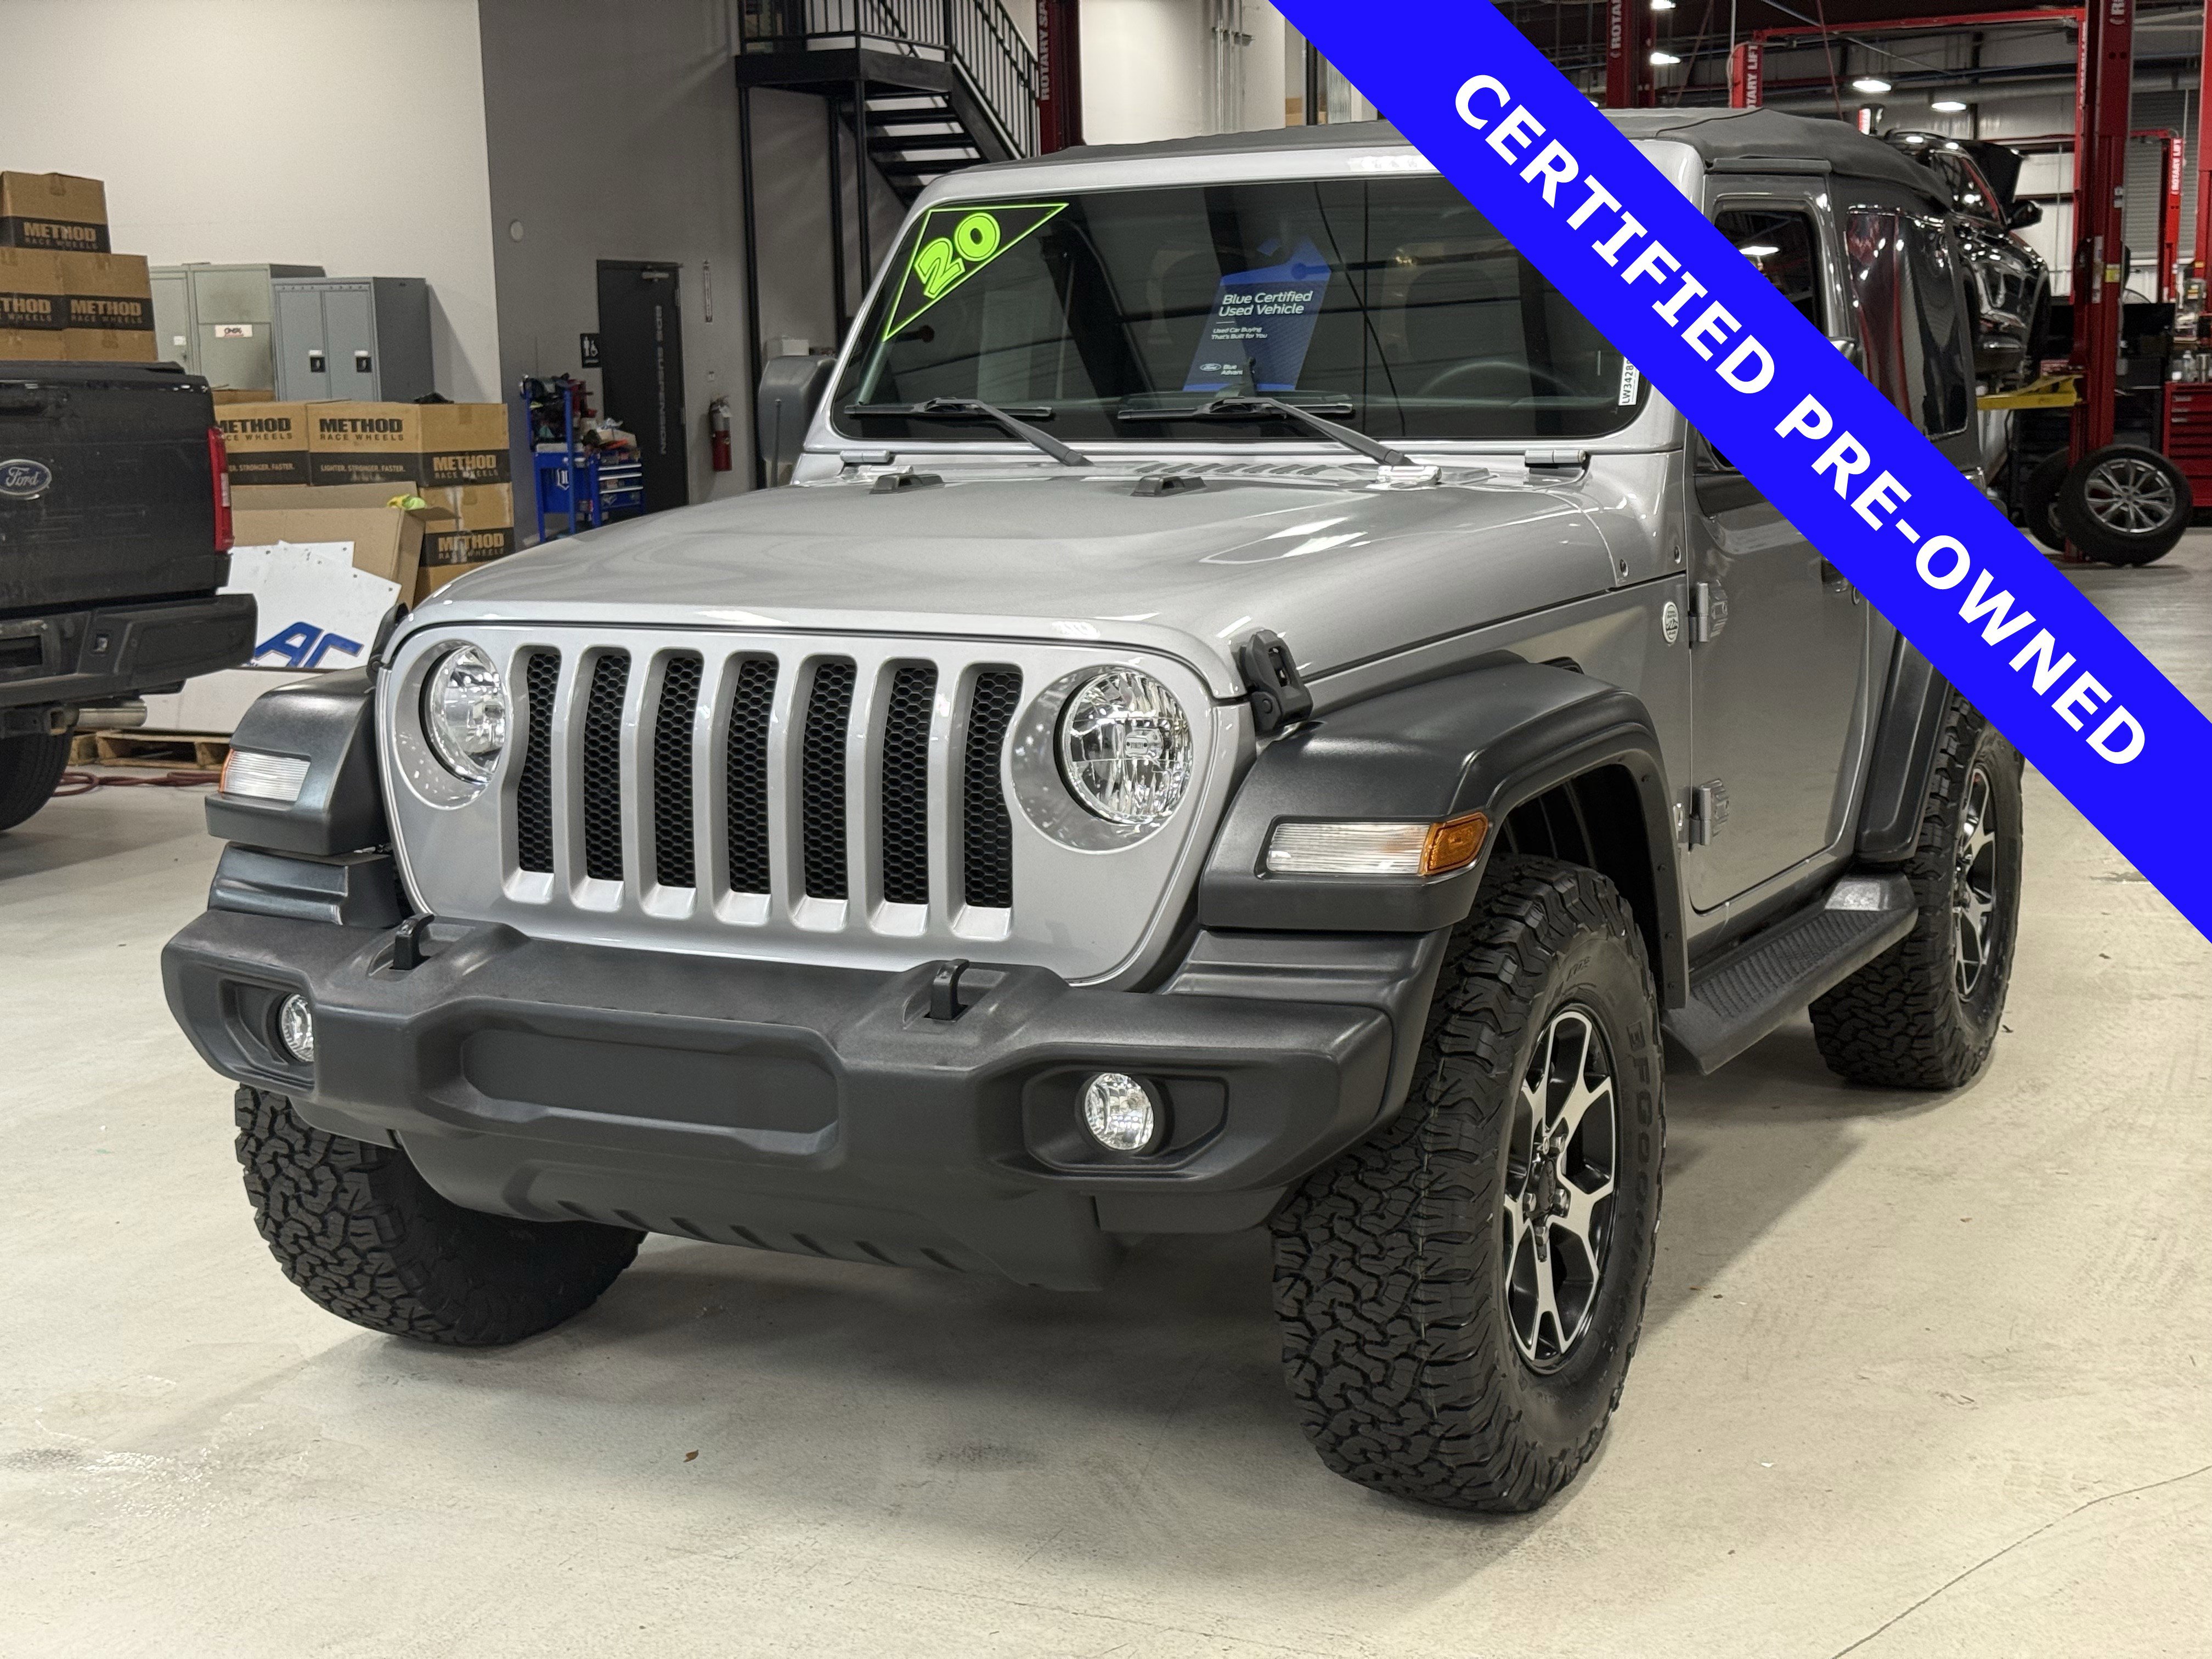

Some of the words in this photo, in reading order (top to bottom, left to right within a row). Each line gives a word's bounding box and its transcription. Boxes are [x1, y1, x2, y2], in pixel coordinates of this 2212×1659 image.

[1039, 29, 1049, 100] ROTARY
[24, 222, 97, 241] METHOD
[914, 212, 1000, 299] 20
[1222, 294, 1252, 304] Blue
[1255, 291, 1313, 303] Certified
[0, 298, 52, 314] THOD
[70, 299, 142, 316] METHOD
[1218, 304, 1254, 317] Used
[1257, 303, 1304, 315] Vehicle
[319, 418, 403, 433] METHOD
[246, 432, 292, 441] WHEELS
[356, 433, 404, 441] WHEELS
[433, 455, 496, 471] METHOD
[6, 466, 41, 487] Ford
